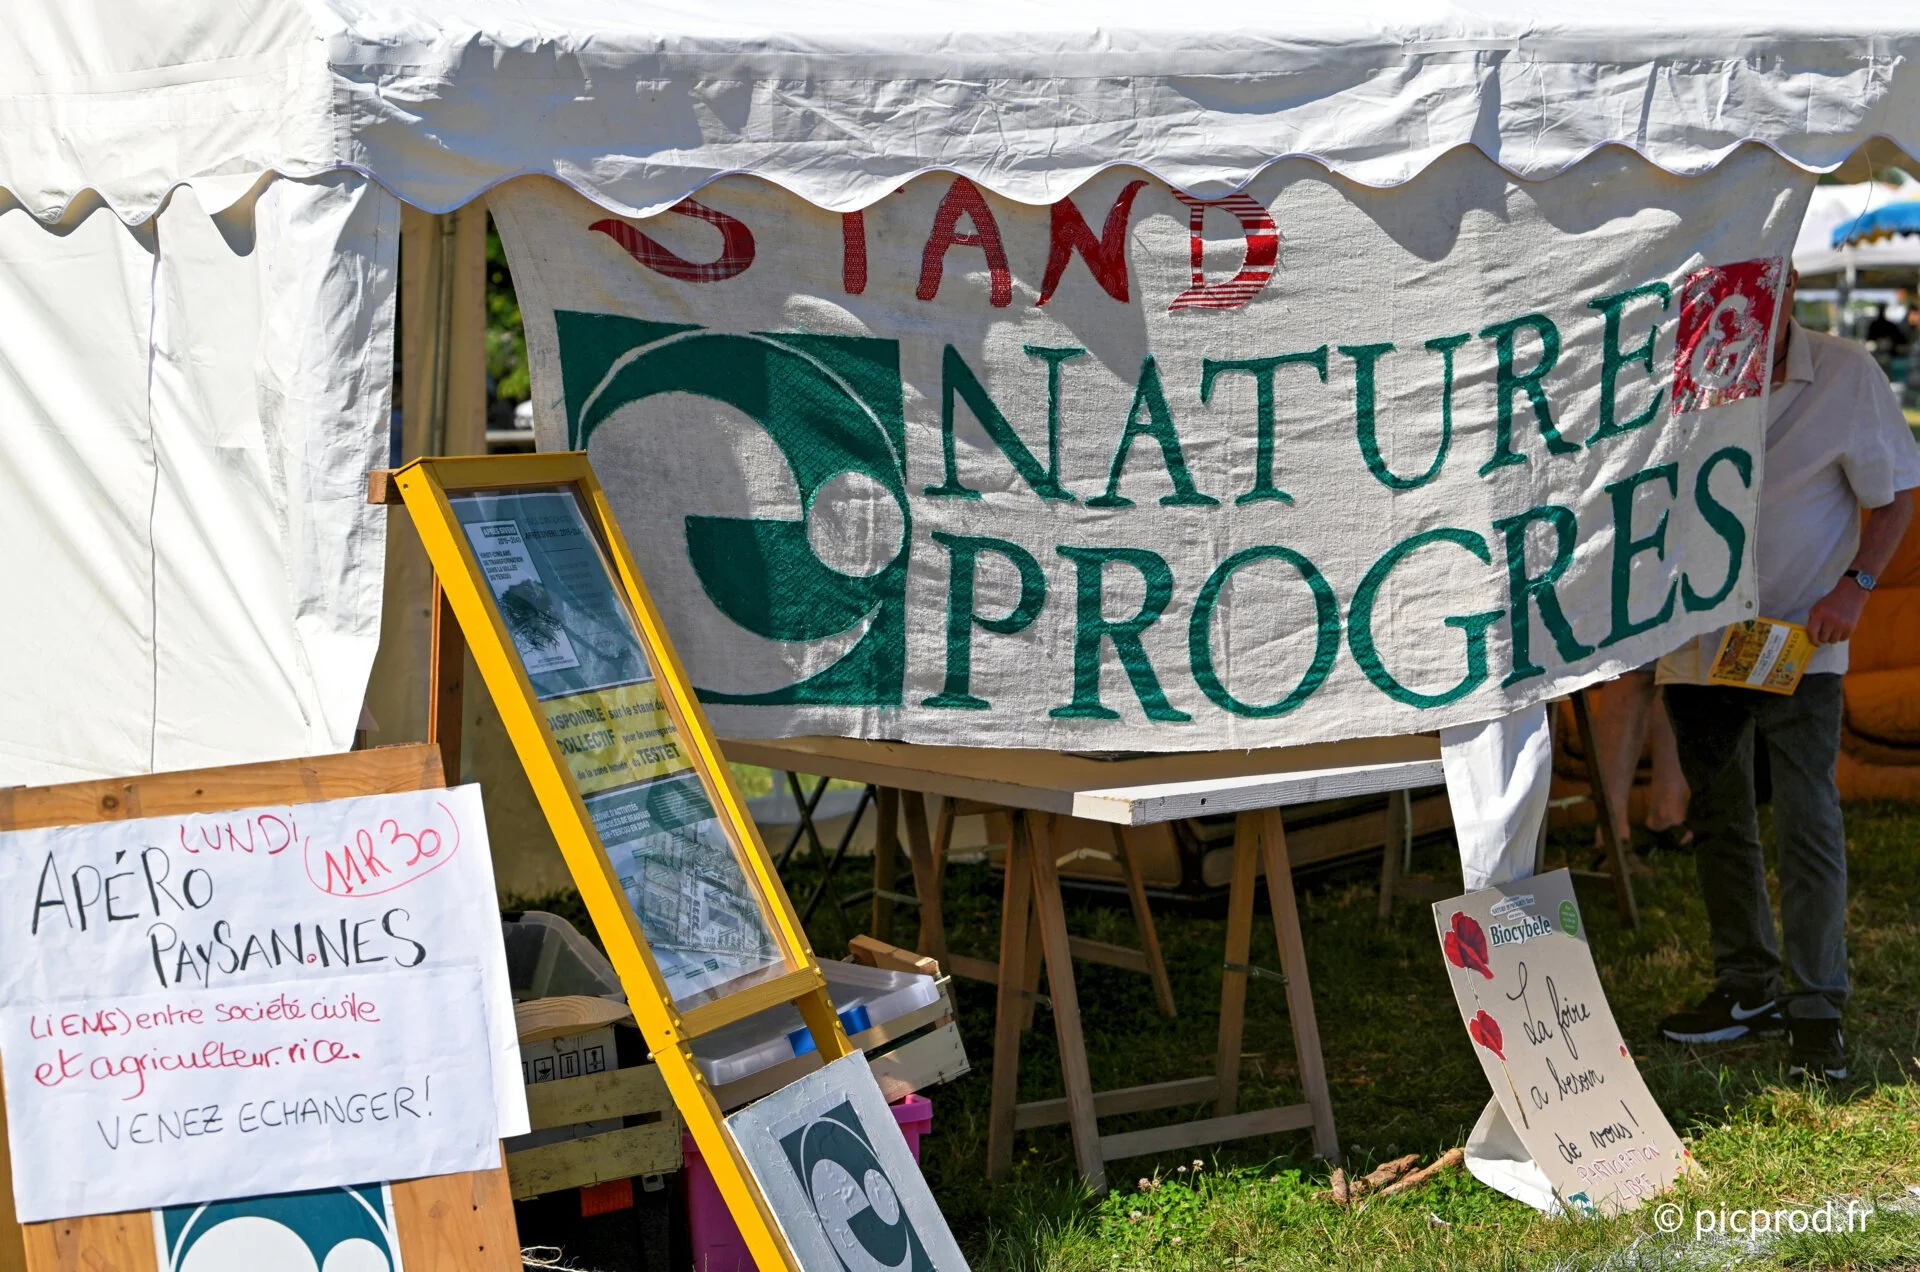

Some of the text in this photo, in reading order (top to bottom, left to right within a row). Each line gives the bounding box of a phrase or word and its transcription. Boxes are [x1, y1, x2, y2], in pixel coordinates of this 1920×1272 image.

[923, 281, 1673, 508] NATURE
[921, 444, 1754, 719] PROGRES
[608, 706, 621, 719] sur
[623, 704, 632, 716] le
[633, 701, 655, 714] stand
[635, 742, 680, 766] TESTET
[1490, 915, 1551, 945] Biocybèle
[216, 993, 305, 1023] société
[311, 992, 380, 1023] civile
[1546, 975, 1591, 1060] foire
[34, 1048, 83, 1087] et
[1531, 1057, 1605, 1110] a besoin
[97, 1105, 223, 1150] VENEZ
[1555, 1132, 1582, 1165] de
[1614, 1172, 1655, 1200] LIBRE
